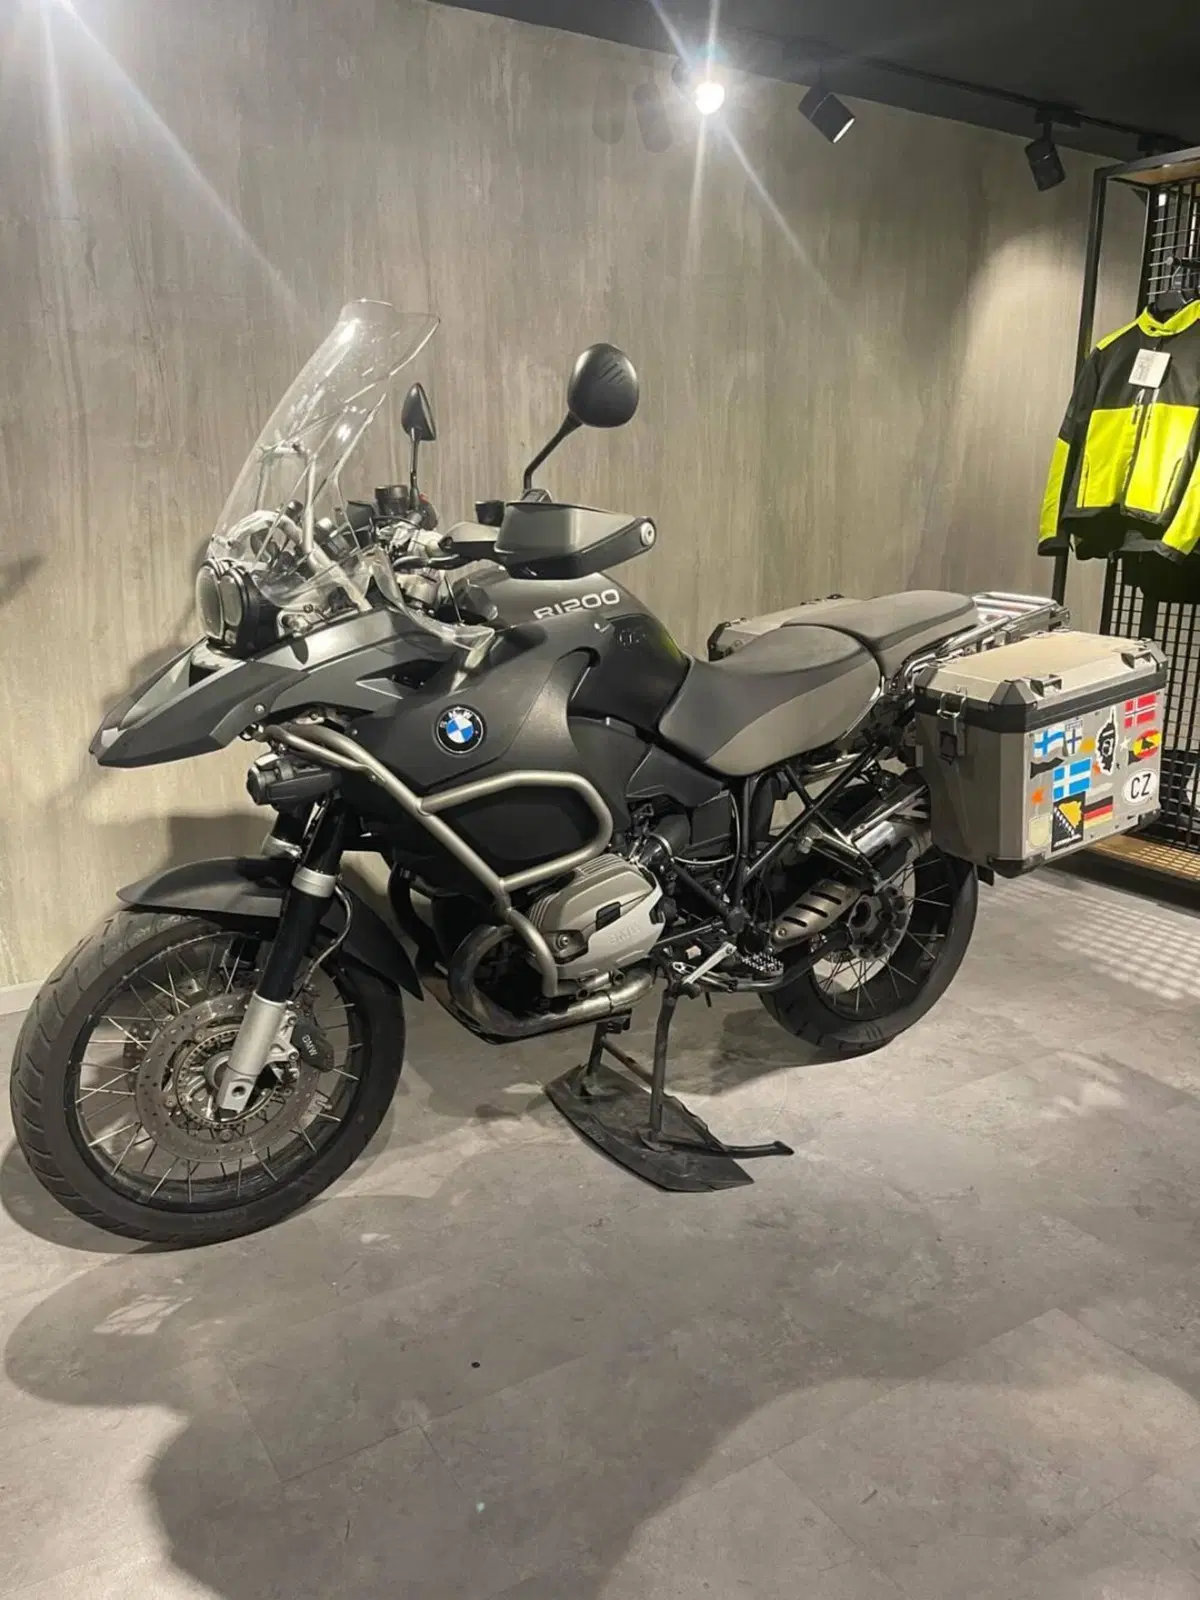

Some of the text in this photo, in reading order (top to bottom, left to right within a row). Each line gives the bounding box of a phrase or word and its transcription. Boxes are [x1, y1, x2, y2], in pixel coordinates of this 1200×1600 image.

[533, 588, 620, 619] R1200
[439, 709, 474, 729] BMW
[1130, 772, 1152, 799] CZ
[301, 1034, 318, 1057] BMW
